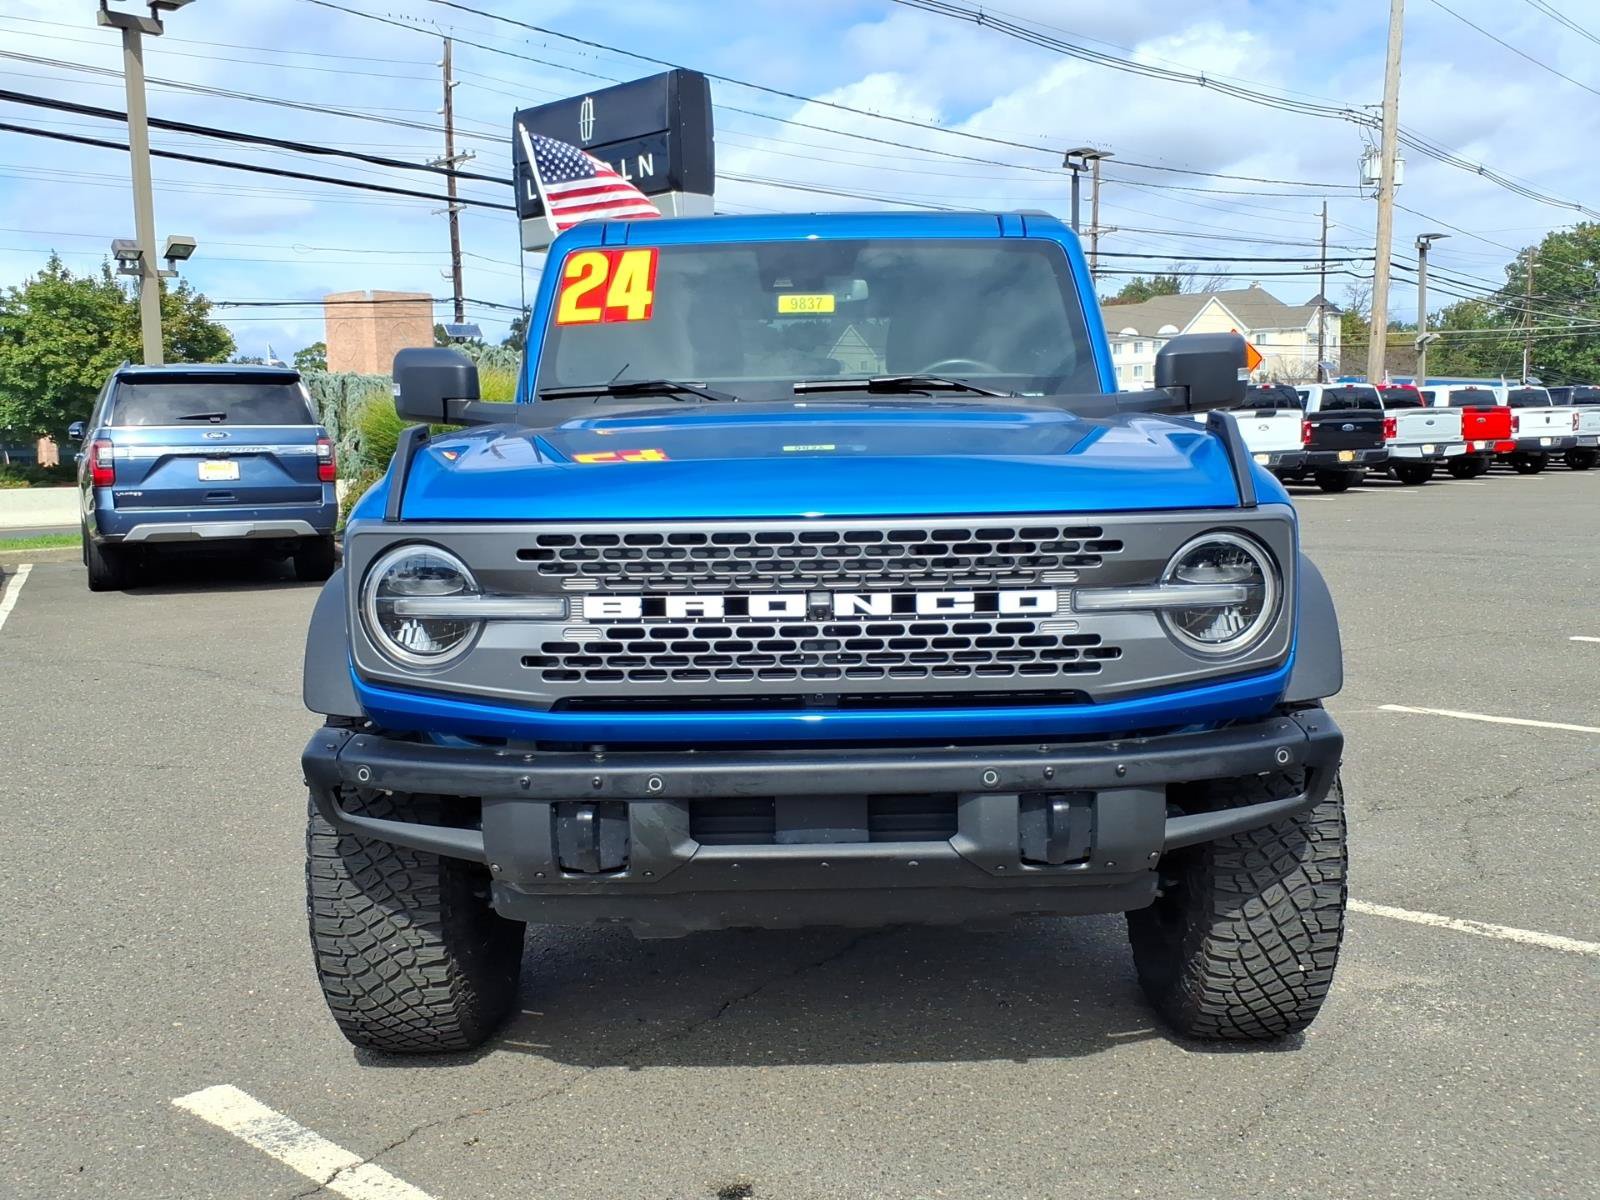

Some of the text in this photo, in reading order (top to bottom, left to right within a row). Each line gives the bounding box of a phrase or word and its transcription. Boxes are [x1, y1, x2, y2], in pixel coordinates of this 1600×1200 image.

[556, 249, 653, 324] 24
[790, 297, 823, 310] 9837
[583, 590, 1058, 620] BRONCO
